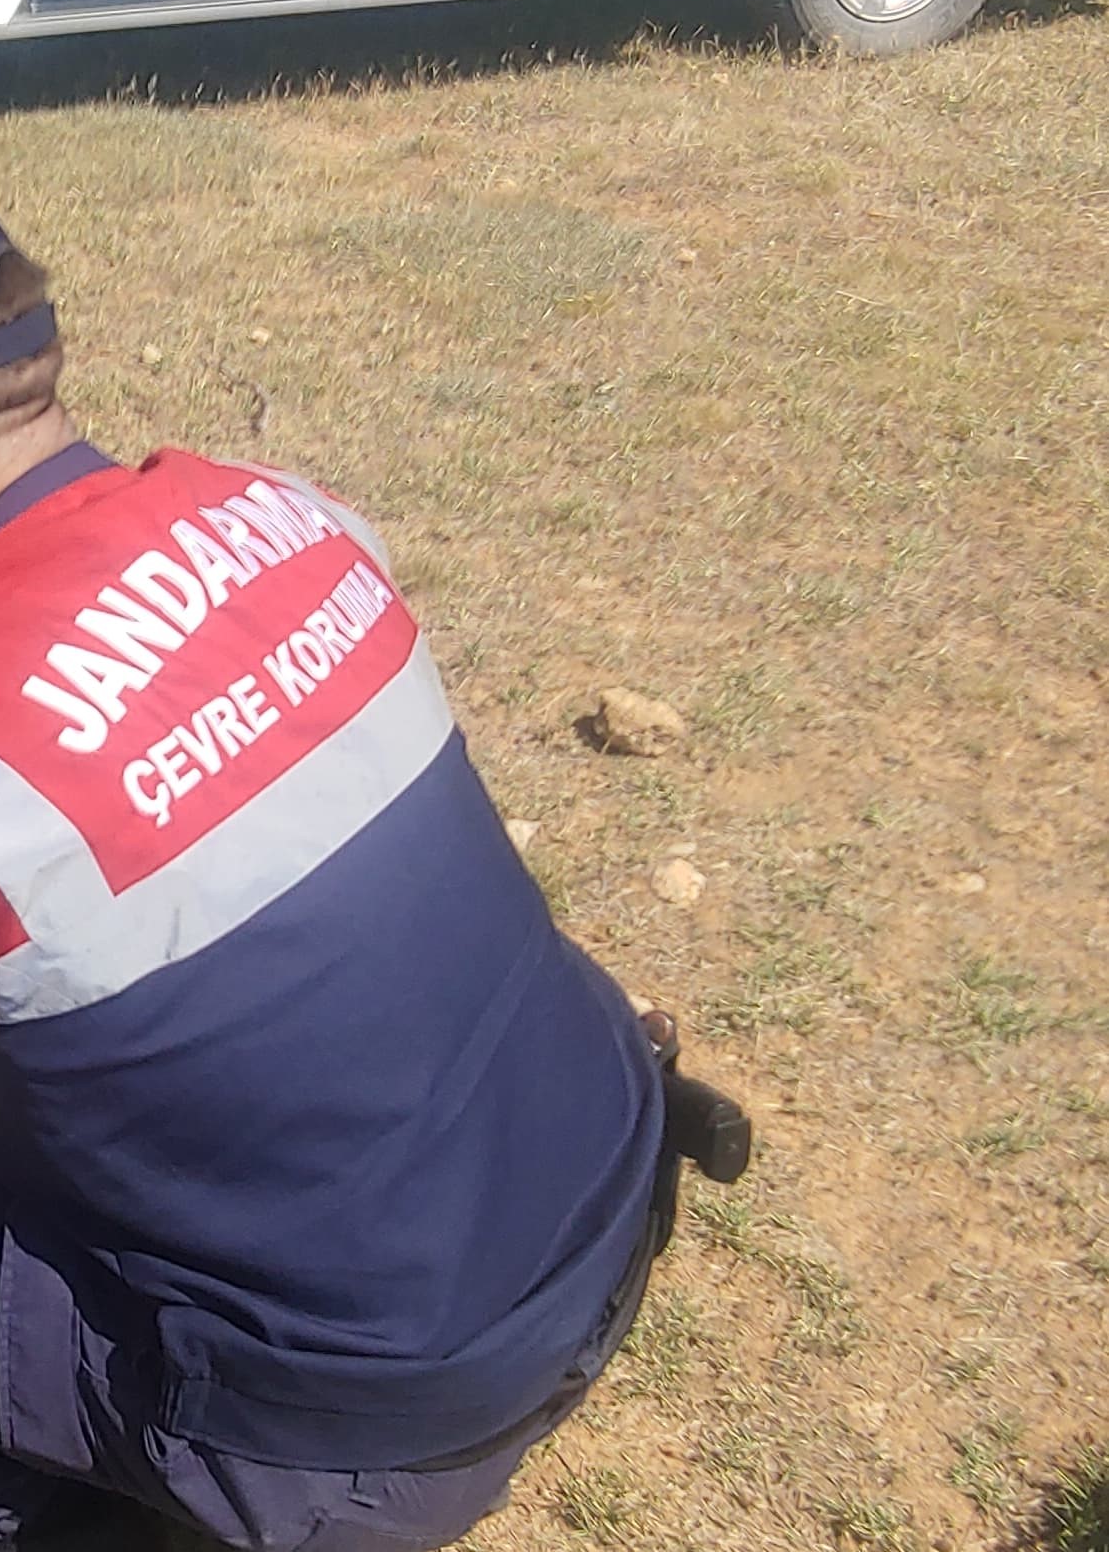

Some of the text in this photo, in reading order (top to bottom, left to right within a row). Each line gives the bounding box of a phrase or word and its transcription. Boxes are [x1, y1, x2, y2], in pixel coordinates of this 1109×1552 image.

[21, 479, 344, 754] JANDARMA
[122, 560, 393, 828] ÇEVRE KORUMA
